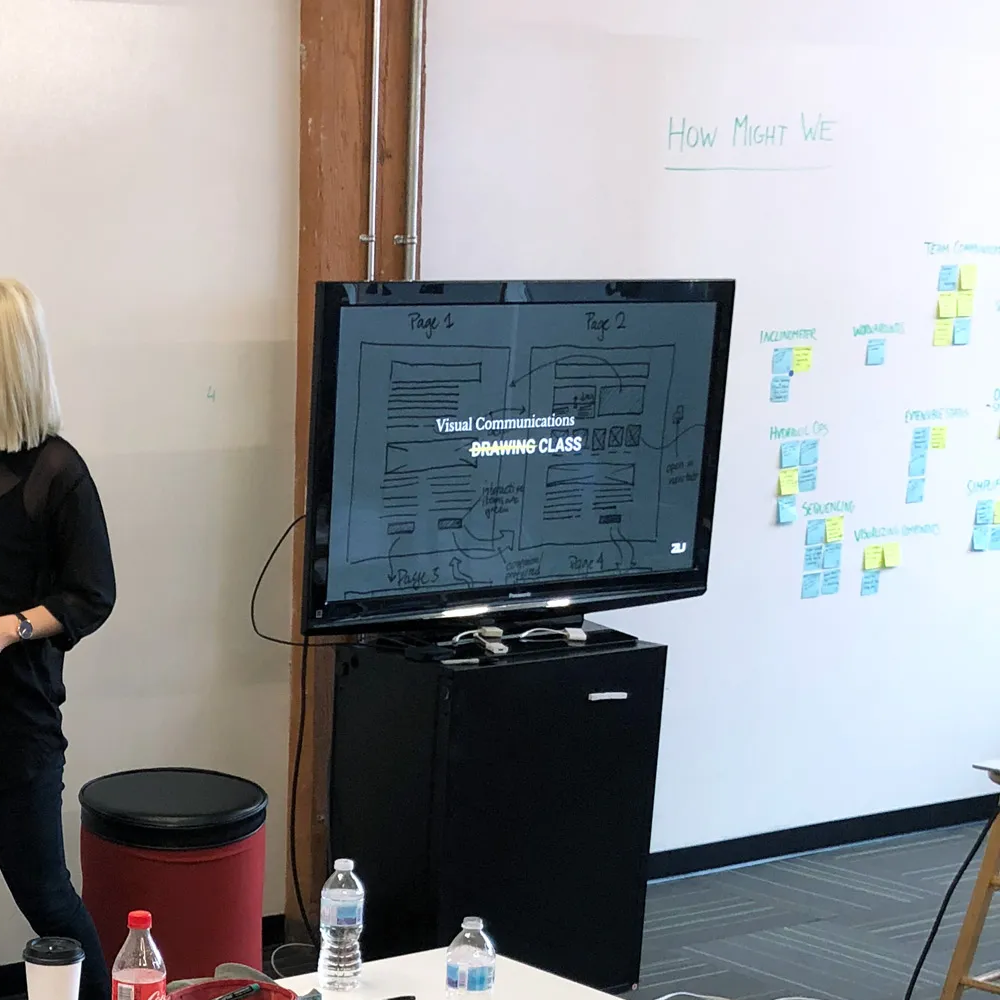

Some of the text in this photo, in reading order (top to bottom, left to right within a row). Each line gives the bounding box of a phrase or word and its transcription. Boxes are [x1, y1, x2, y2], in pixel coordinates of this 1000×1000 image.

[668, 111, 838, 152] HOW MIGHT WE
[408, 312, 438, 338] Page
[585, 312, 627, 341] Page 2
[436, 413, 575, 433] Visual Communications
[470, 436, 582, 458] DRAWING CLASS
